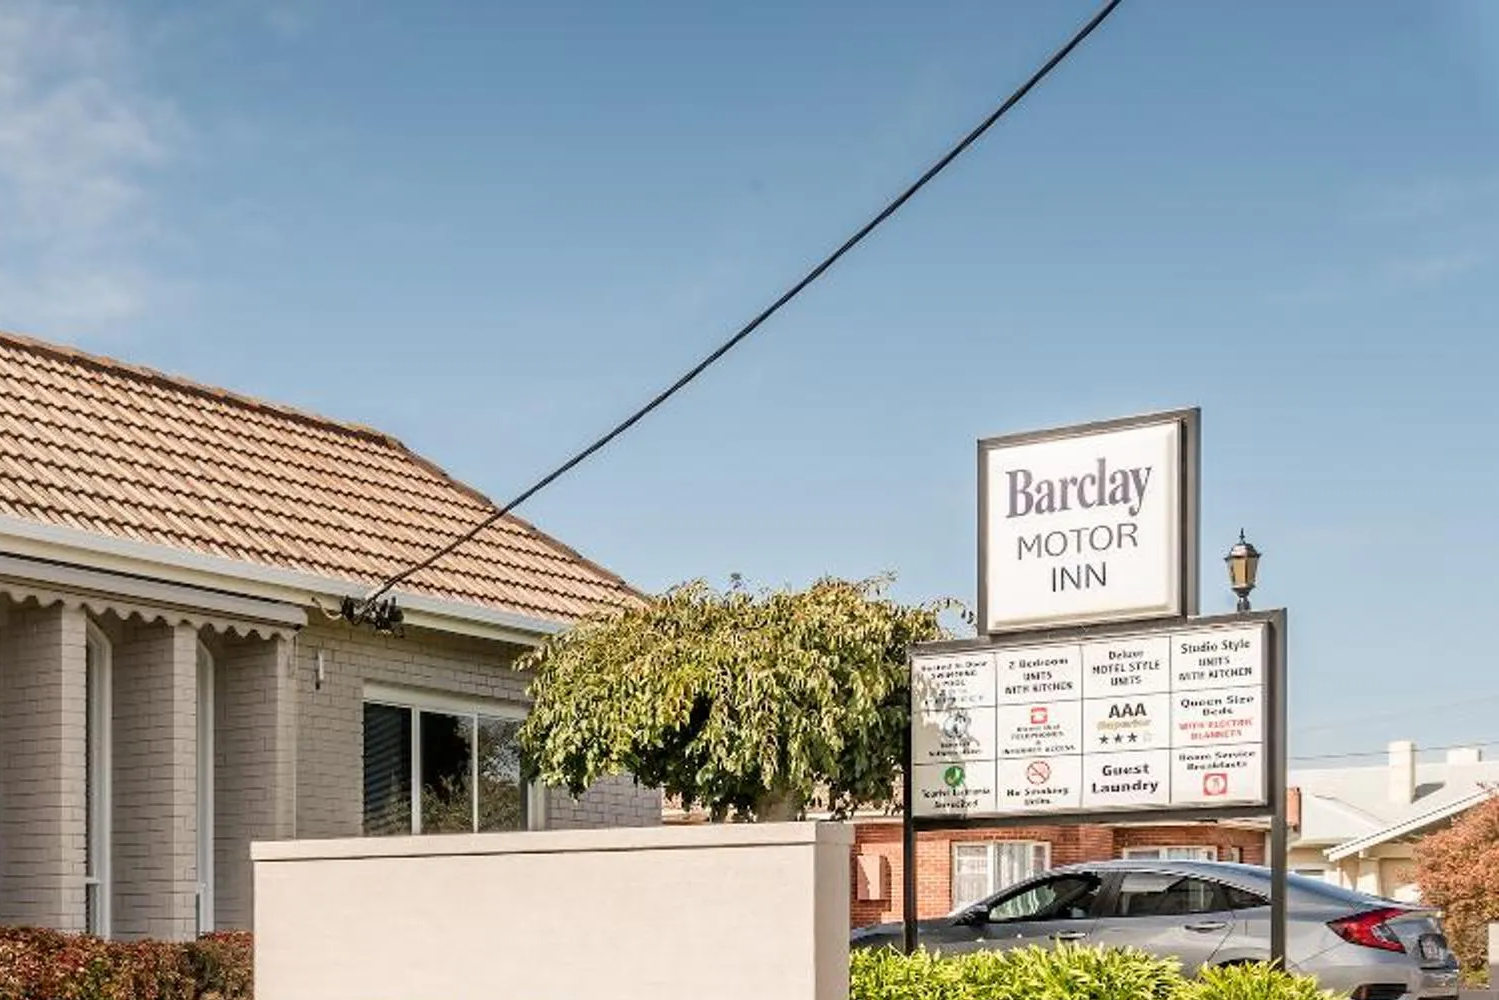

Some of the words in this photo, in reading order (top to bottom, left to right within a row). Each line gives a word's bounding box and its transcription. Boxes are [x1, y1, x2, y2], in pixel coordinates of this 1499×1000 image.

[1005, 457, 1152, 518] Barclay
[1017, 523, 1138, 560] MOTOR
[1052, 562, 1107, 592] INN
[1181, 641, 1218, 654] Studio
[1221, 638, 1251, 652] Style
[1109, 650, 1144, 660] Deluxe
[1199, 656, 1230, 666] UNITS
[1093, 664, 1125, 674] MOTEL
[1129, 660, 1161, 672] STYLE
[1209, 667, 1252, 678] KITCHEN
[1023, 671, 1052, 681] UNITS
[1111, 676, 1142, 686] UNITS
[1033, 681, 1073, 693] KITCHEN
[1181, 699, 1222, 708] Queen
[1226, 696, 1254, 705] Size
[1108, 703, 1147, 719] AAA
[1102, 764, 1150, 776] Guest
[1091, 780, 1159, 793] Laundry
